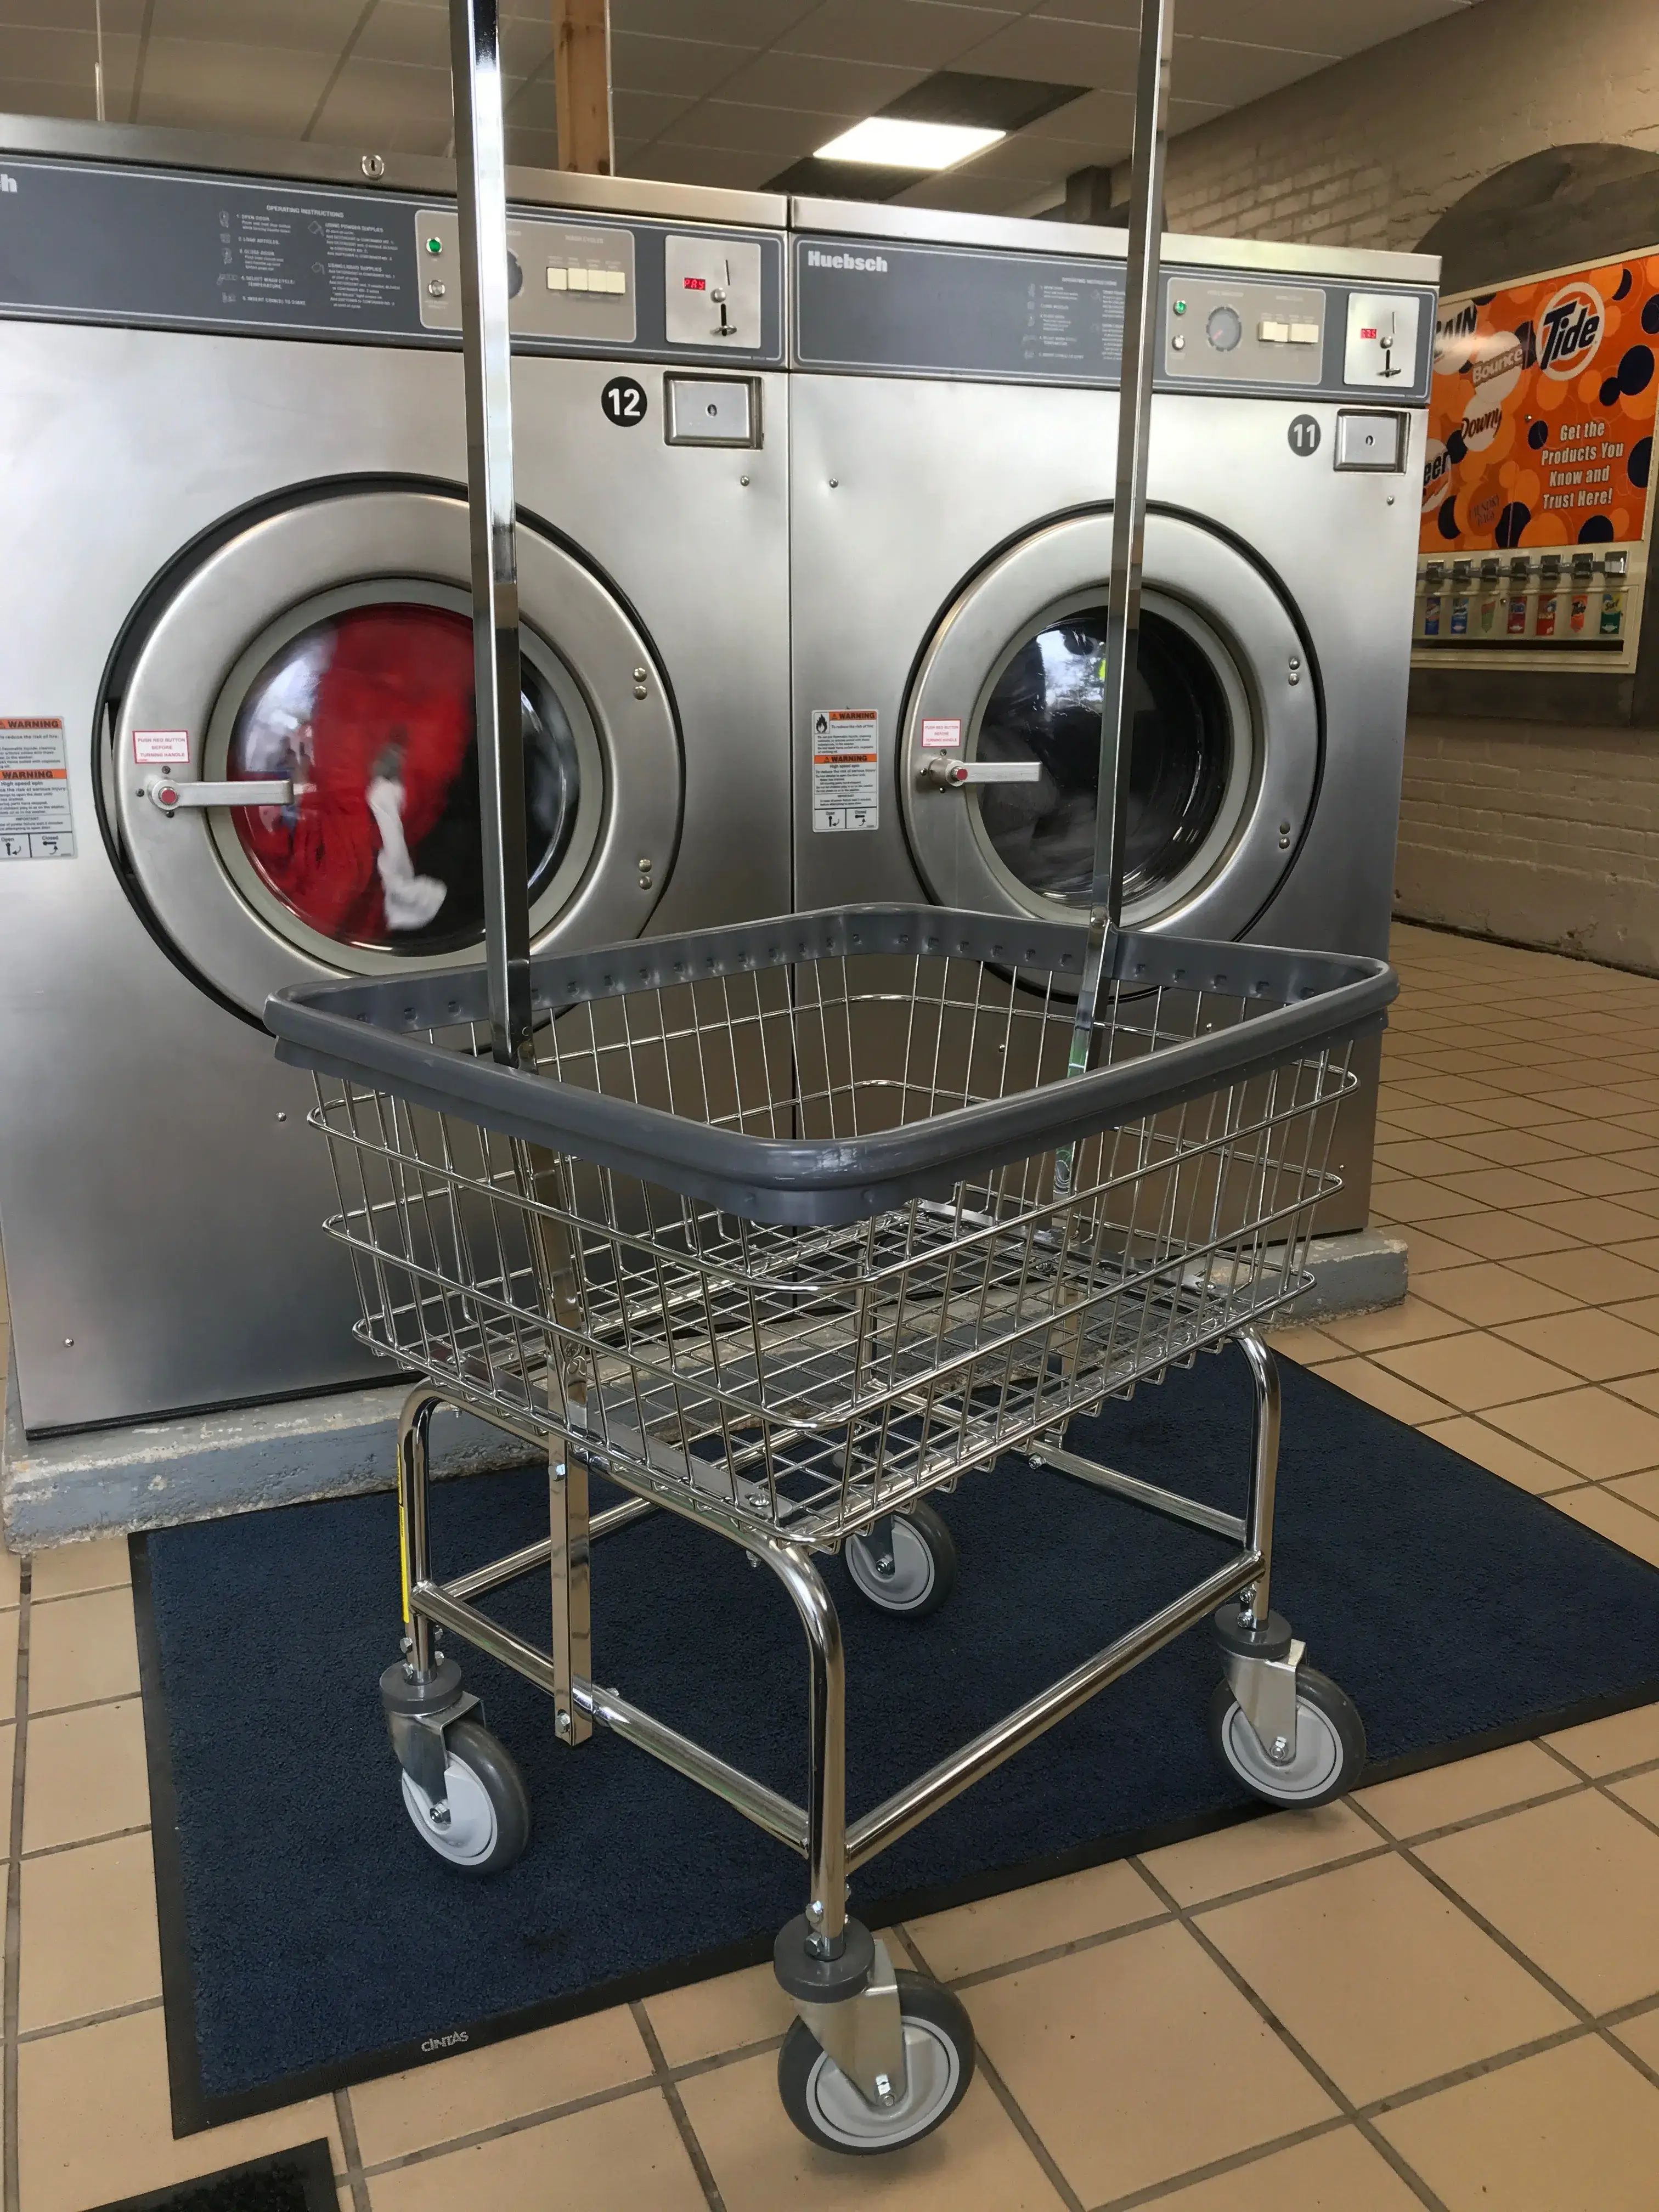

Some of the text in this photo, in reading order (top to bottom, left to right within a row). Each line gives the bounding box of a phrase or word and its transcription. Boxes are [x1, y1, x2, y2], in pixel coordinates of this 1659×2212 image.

[808, 250, 888, 272] Huebsch
[1541, 301, 1600, 370] Tide
[1473, 348, 1523, 381] Bounce
[608, 388, 640, 416] 12
[1462, 408, 1502, 439] Downy
[1560, 421, 1605, 441] Get the
[1294, 424, 1315, 447] 11
[1542, 442, 1624, 466] Products You
[1549, 465, 1610, 487] Know and
[1543, 487, 1613, 510] Trust Here!
